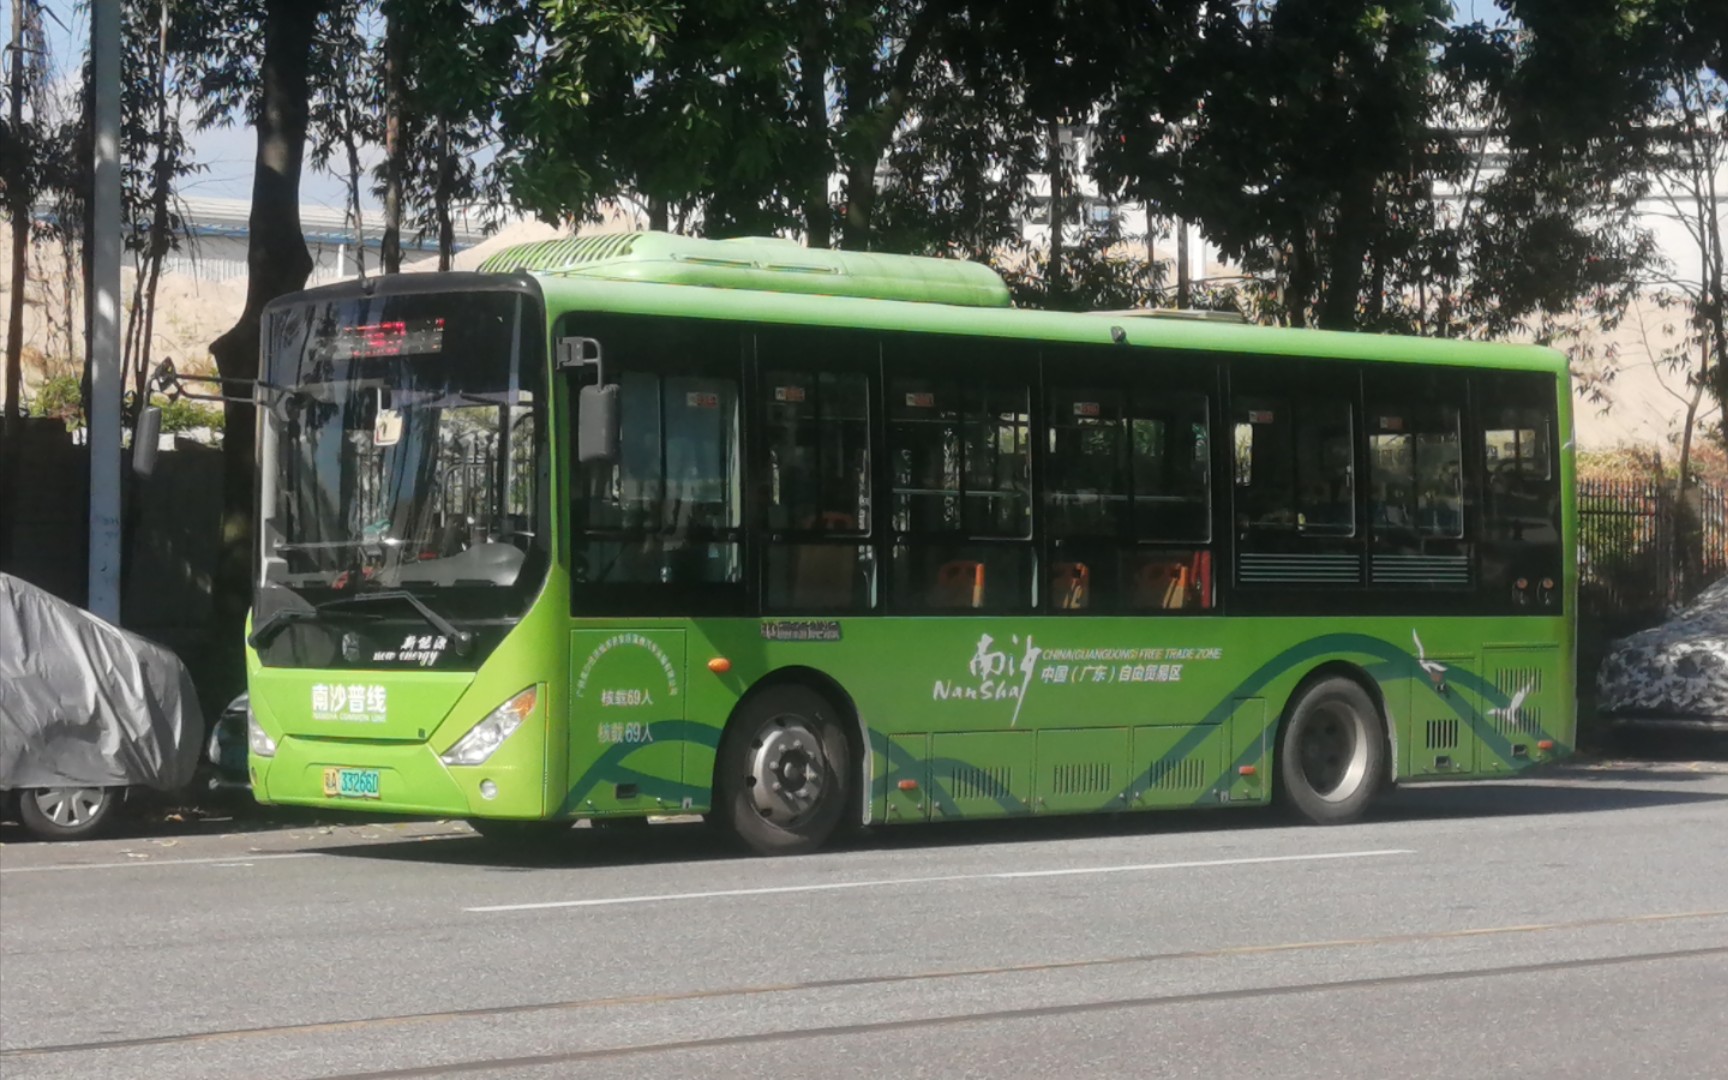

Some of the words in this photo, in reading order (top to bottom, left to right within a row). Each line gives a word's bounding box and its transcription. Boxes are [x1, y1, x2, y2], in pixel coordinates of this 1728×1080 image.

[401, 635, 447, 650] 新能源
[399, 651, 439, 666] energy
[1139, 648, 1164, 660] FREE
[1165, 648, 1196, 660] TRADE
[1196, 648, 1222, 660] ZONE
[933, 680, 1020, 700] NanSha
[312, 684, 387, 712] 南沙普线
